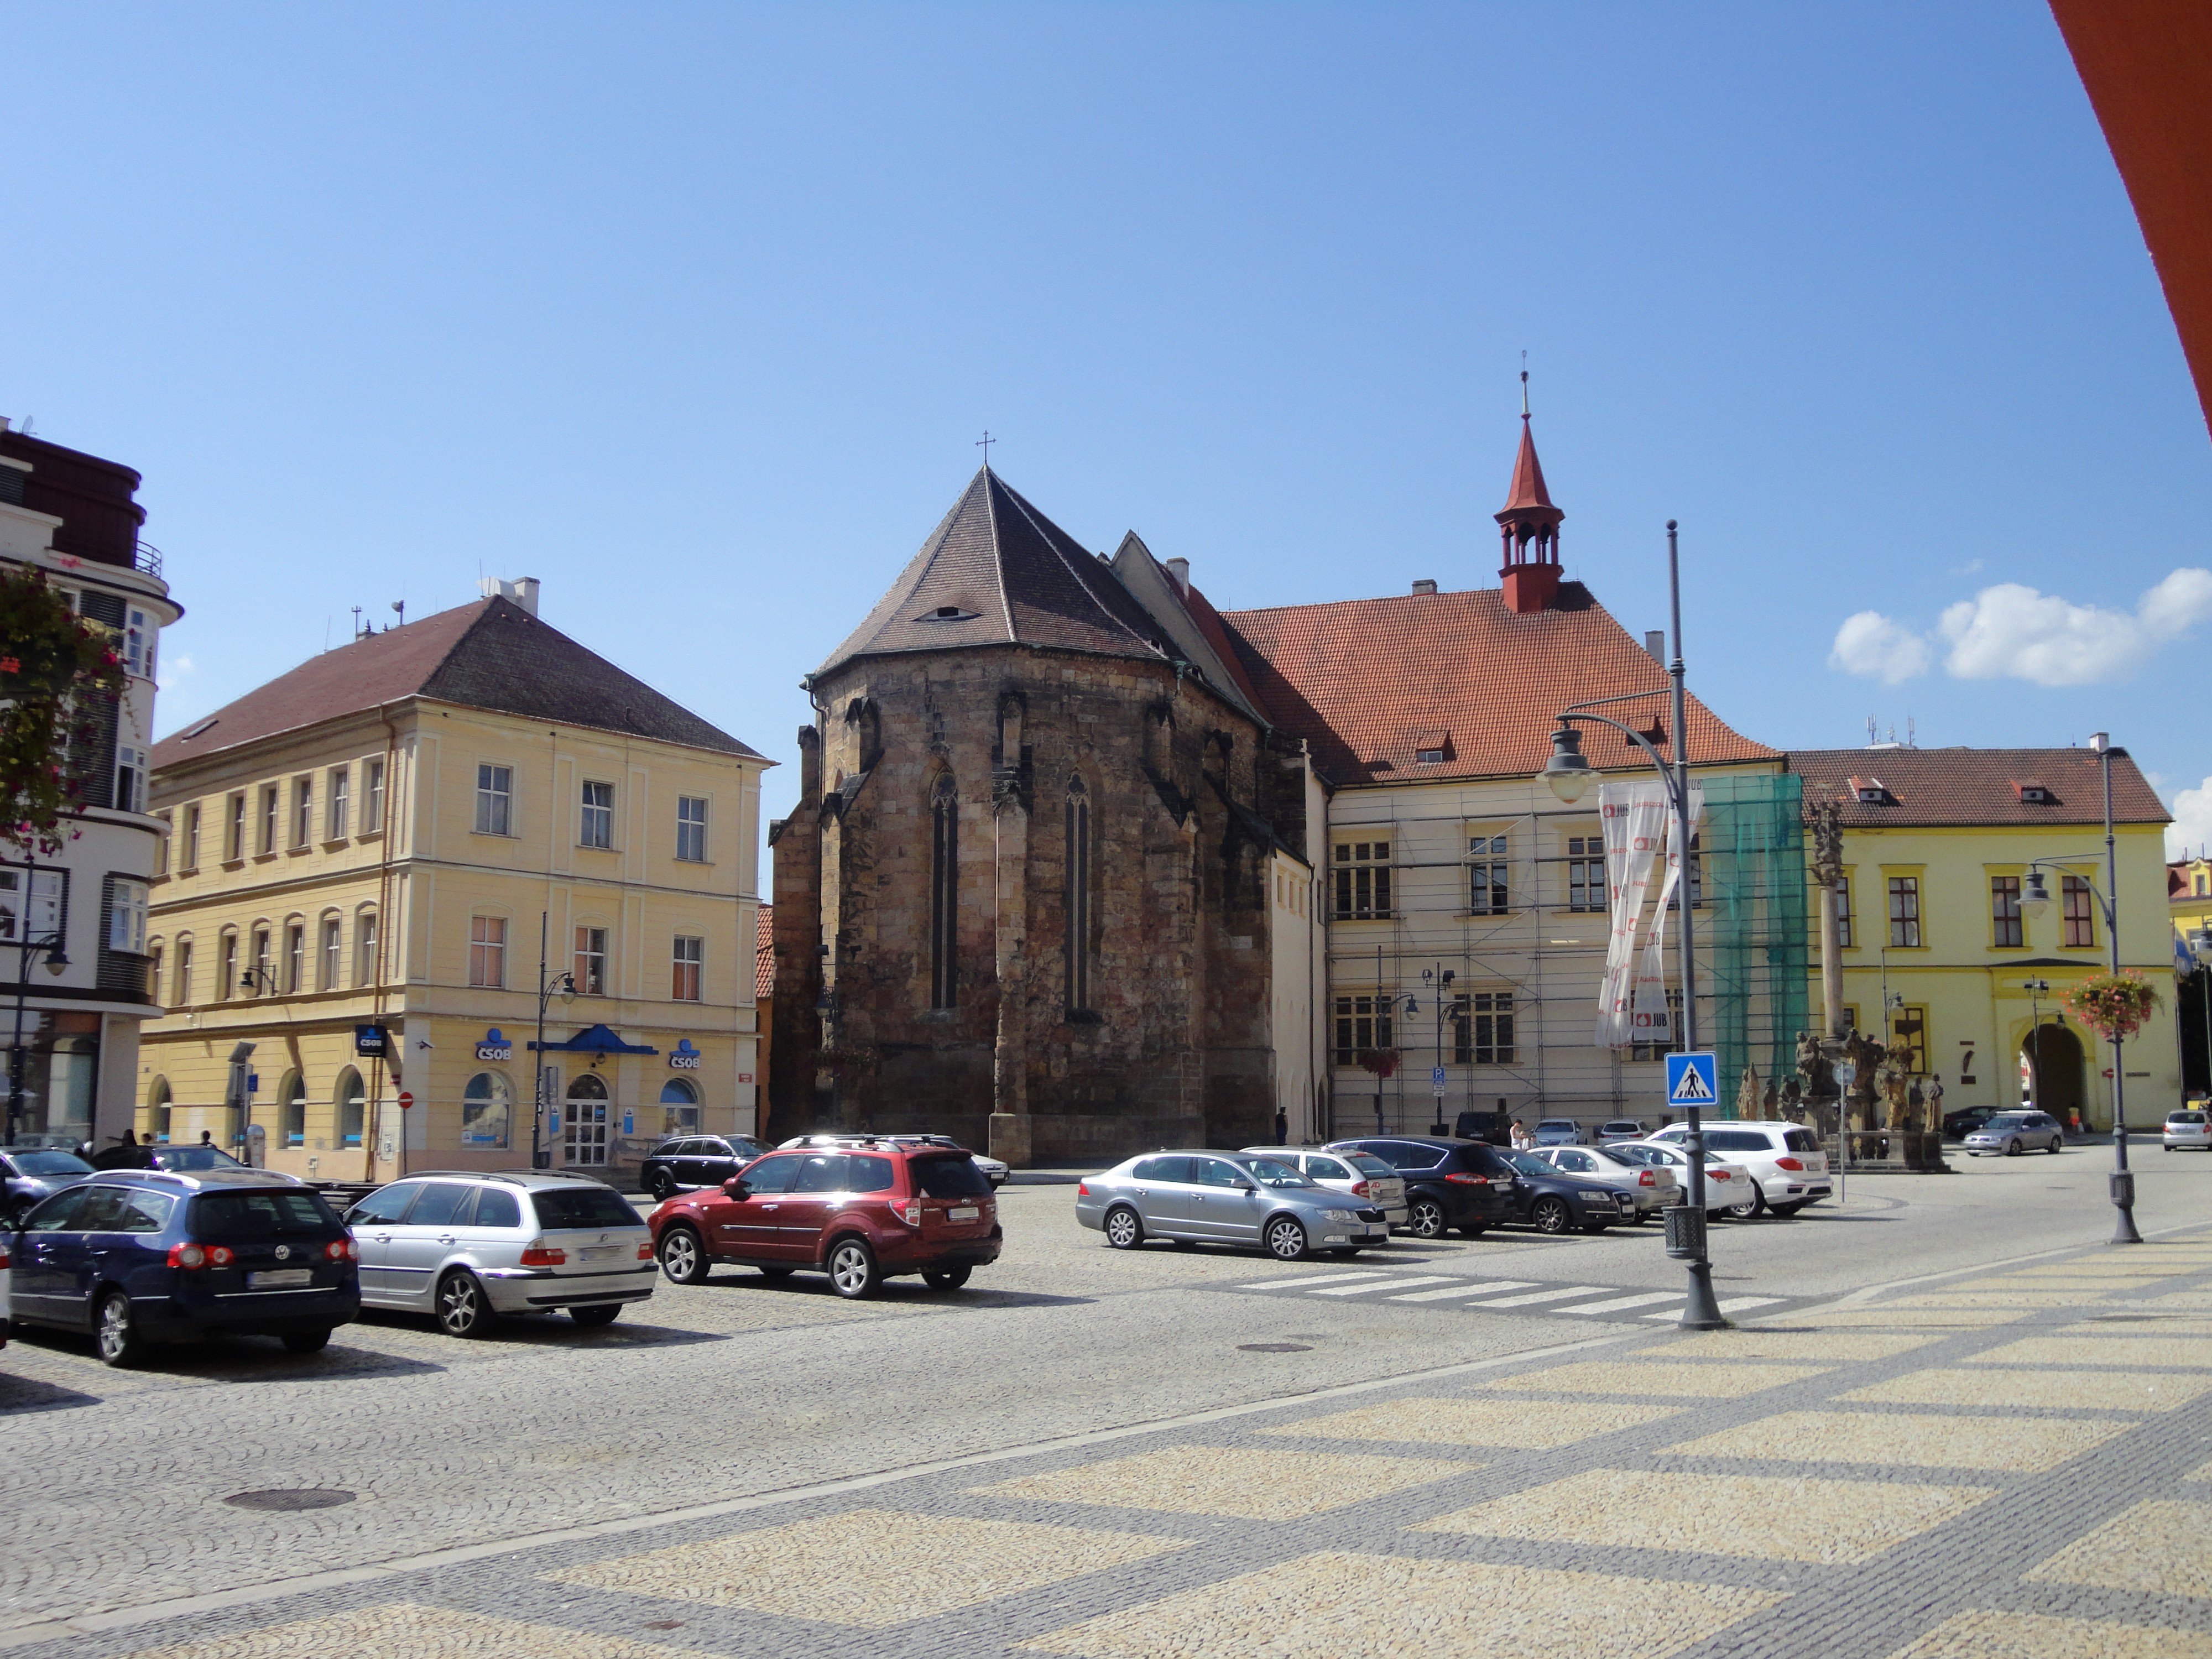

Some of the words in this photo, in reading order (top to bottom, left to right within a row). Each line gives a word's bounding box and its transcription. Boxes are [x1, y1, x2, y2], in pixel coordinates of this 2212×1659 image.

[1615, 803, 1630, 817] JUB
[1652, 1013, 1667, 1027] JUB
[477, 1047, 512, 1060] ČSOB
[671, 1056, 700, 1068] ČSOB
[1435, 1068, 1442, 1078] P
